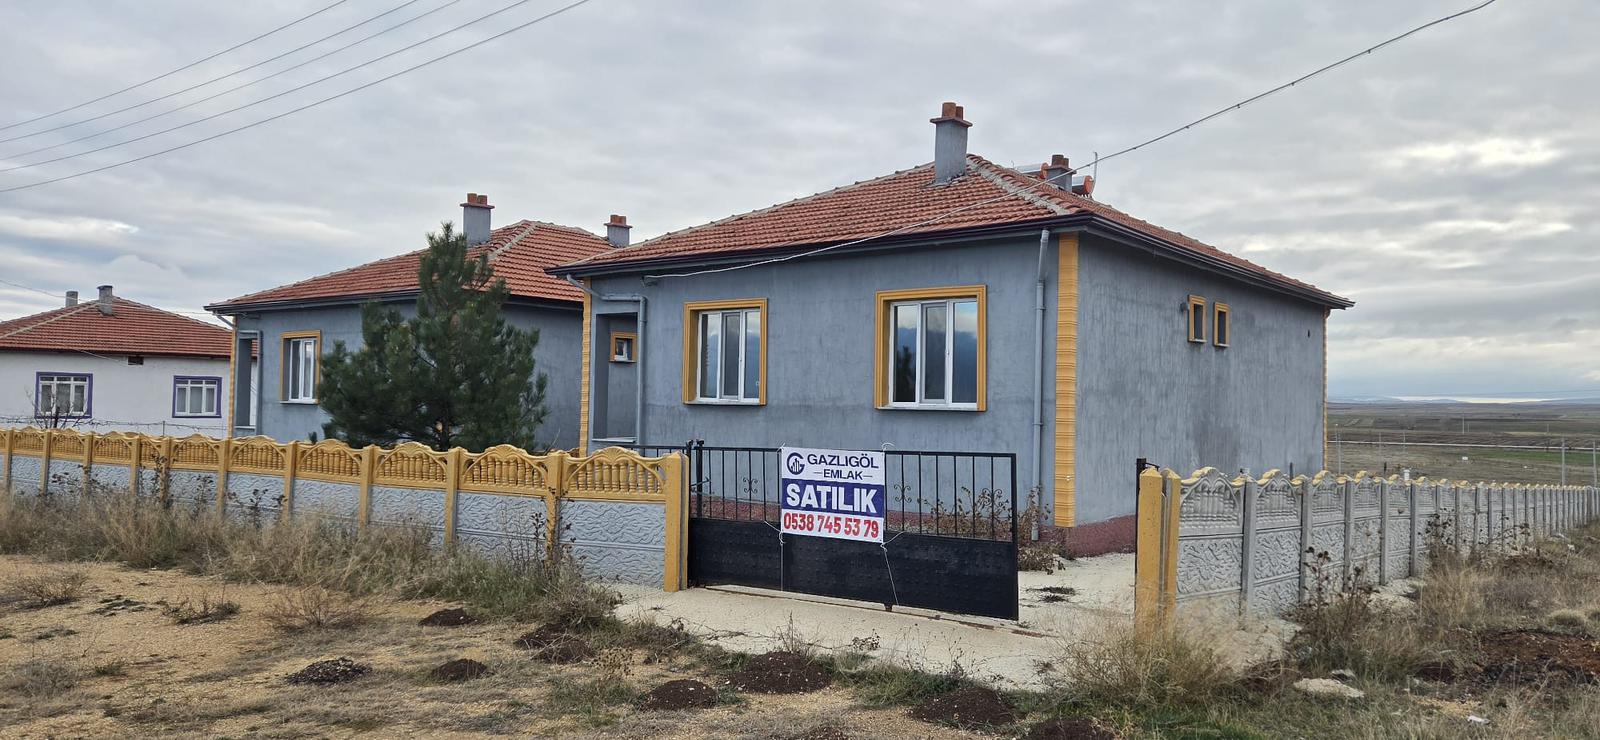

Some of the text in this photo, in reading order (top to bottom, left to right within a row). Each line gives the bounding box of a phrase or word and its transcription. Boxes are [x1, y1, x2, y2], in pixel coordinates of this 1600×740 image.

[807, 453, 879, 469] GAZLIGÖL
[823, 469, 863, 480] EMLAK
[786, 483, 878, 514] SATILIK
[783, 512, 879, 538] 0538 745 53 79
